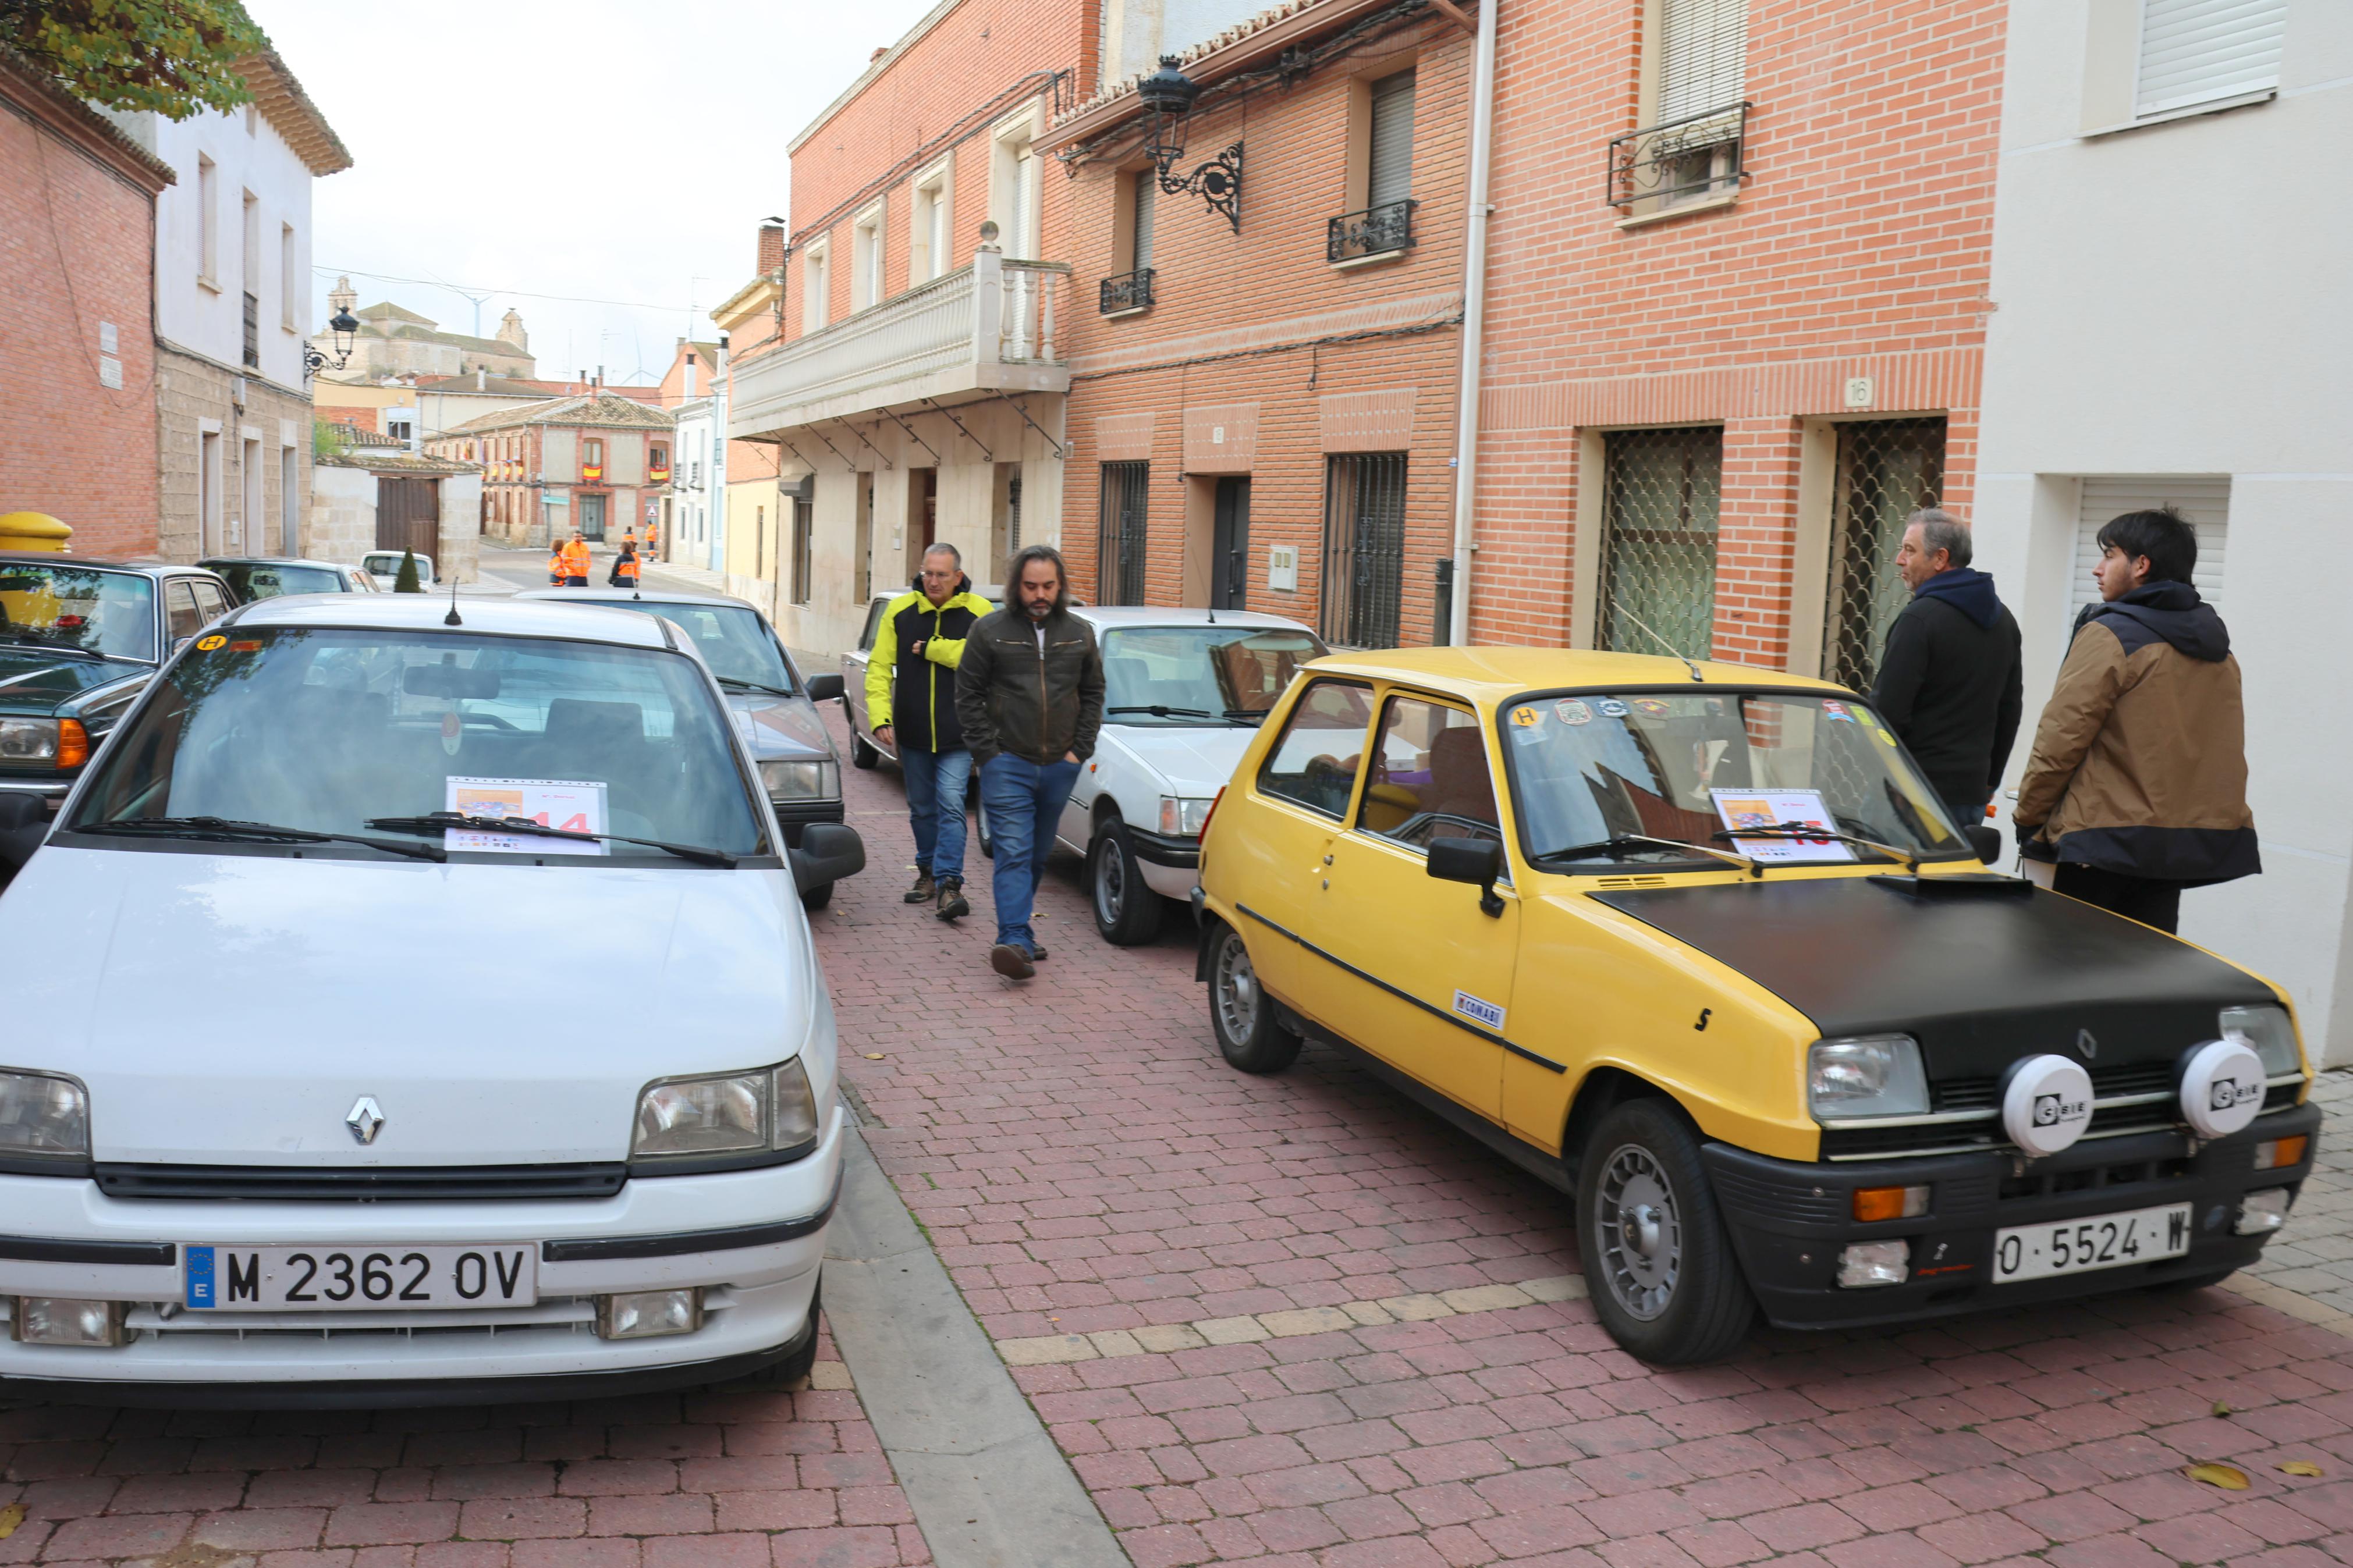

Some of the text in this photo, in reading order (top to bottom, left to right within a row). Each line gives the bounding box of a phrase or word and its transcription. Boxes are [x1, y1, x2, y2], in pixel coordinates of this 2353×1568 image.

[1851, 381, 1868, 401] 16
[202, 637, 221, 648] H
[1517, 709, 1535, 724] H
[2052, 1218, 2139, 1268] 5524
[228, 1251, 524, 1302] M 2362 OV
[194, 1283, 208, 1297] E
